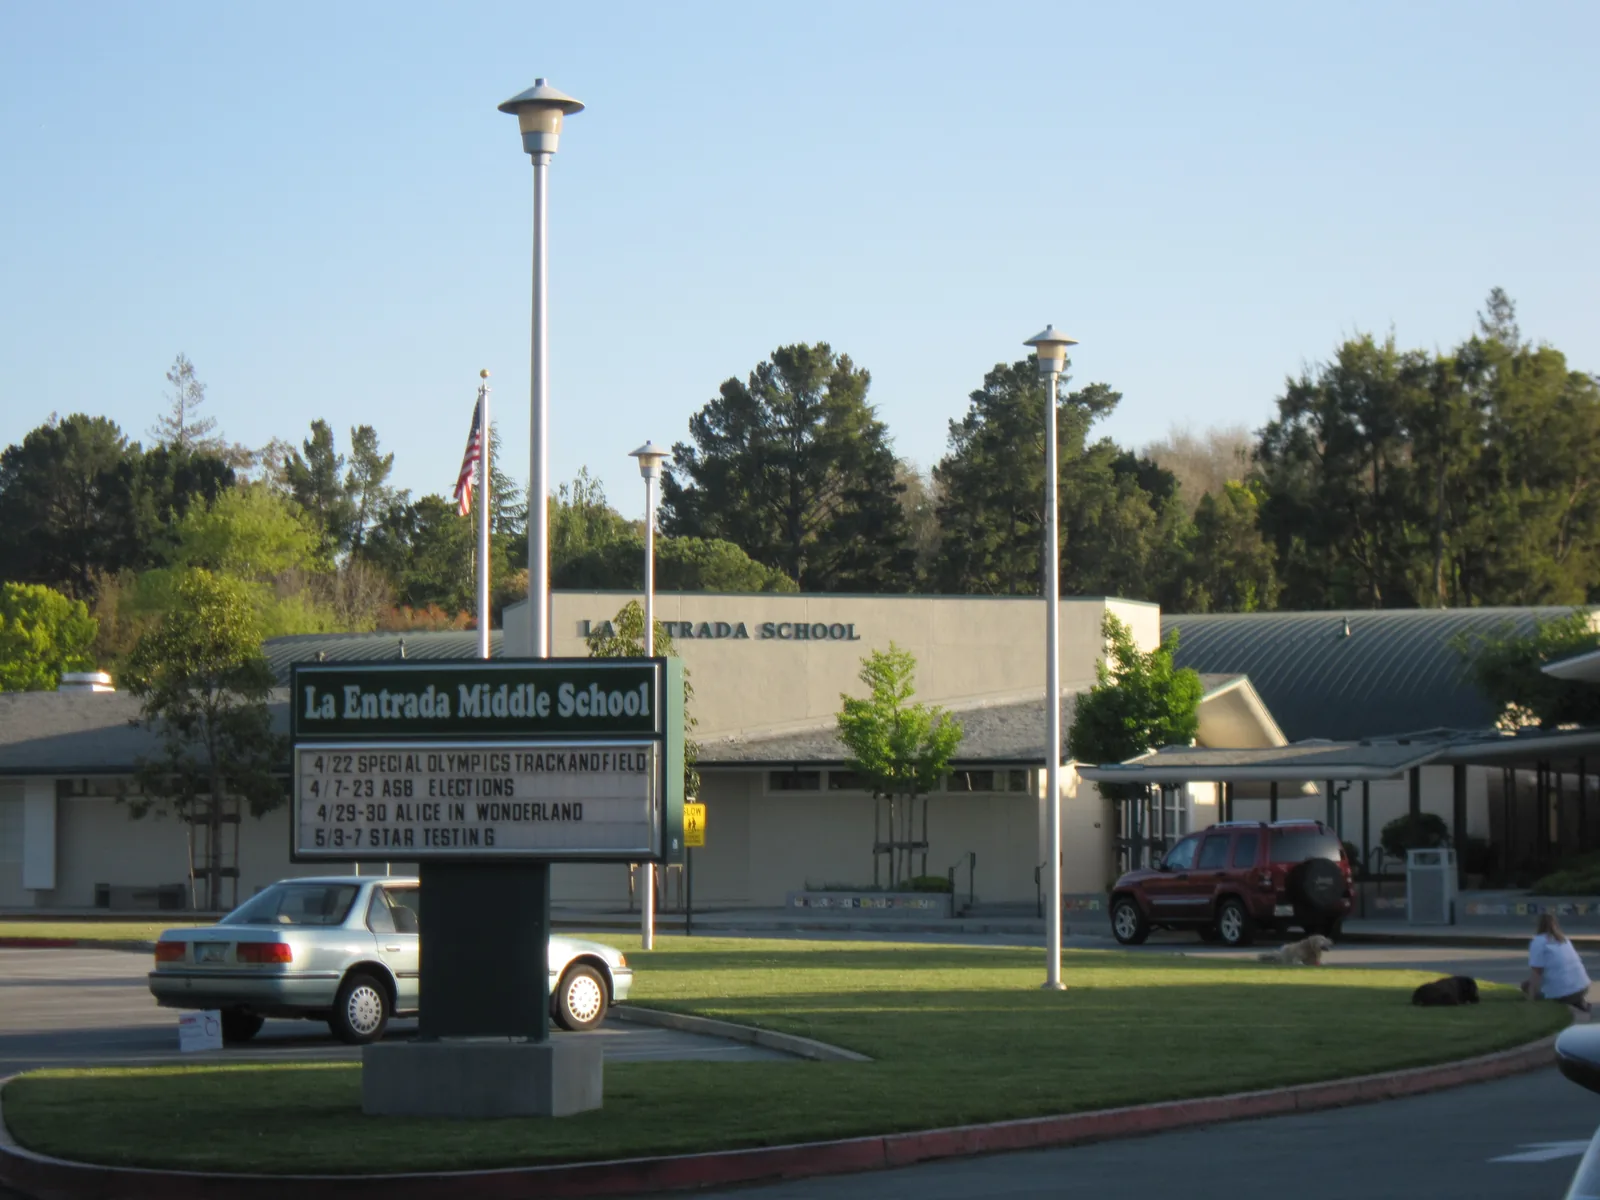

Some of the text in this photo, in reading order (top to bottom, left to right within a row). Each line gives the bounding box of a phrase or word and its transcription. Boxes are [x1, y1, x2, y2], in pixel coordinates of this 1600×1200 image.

[582, 619, 860, 640] LA TRADA SCHOOL
[304, 681, 650, 719] La Entrada Middle School
[315, 755, 353, 774] 4/22
[358, 754, 423, 773] SPECIAL
[427, 753, 511, 773] OLYMPICS
[382, 779, 413, 797] ASB
[429, 778, 515, 797] ELECTIONS
[317, 802, 583, 822] 4/29-30 ALICE IN WONDERLAND
[315, 827, 495, 847] 5/3-7 STAR TESTING
